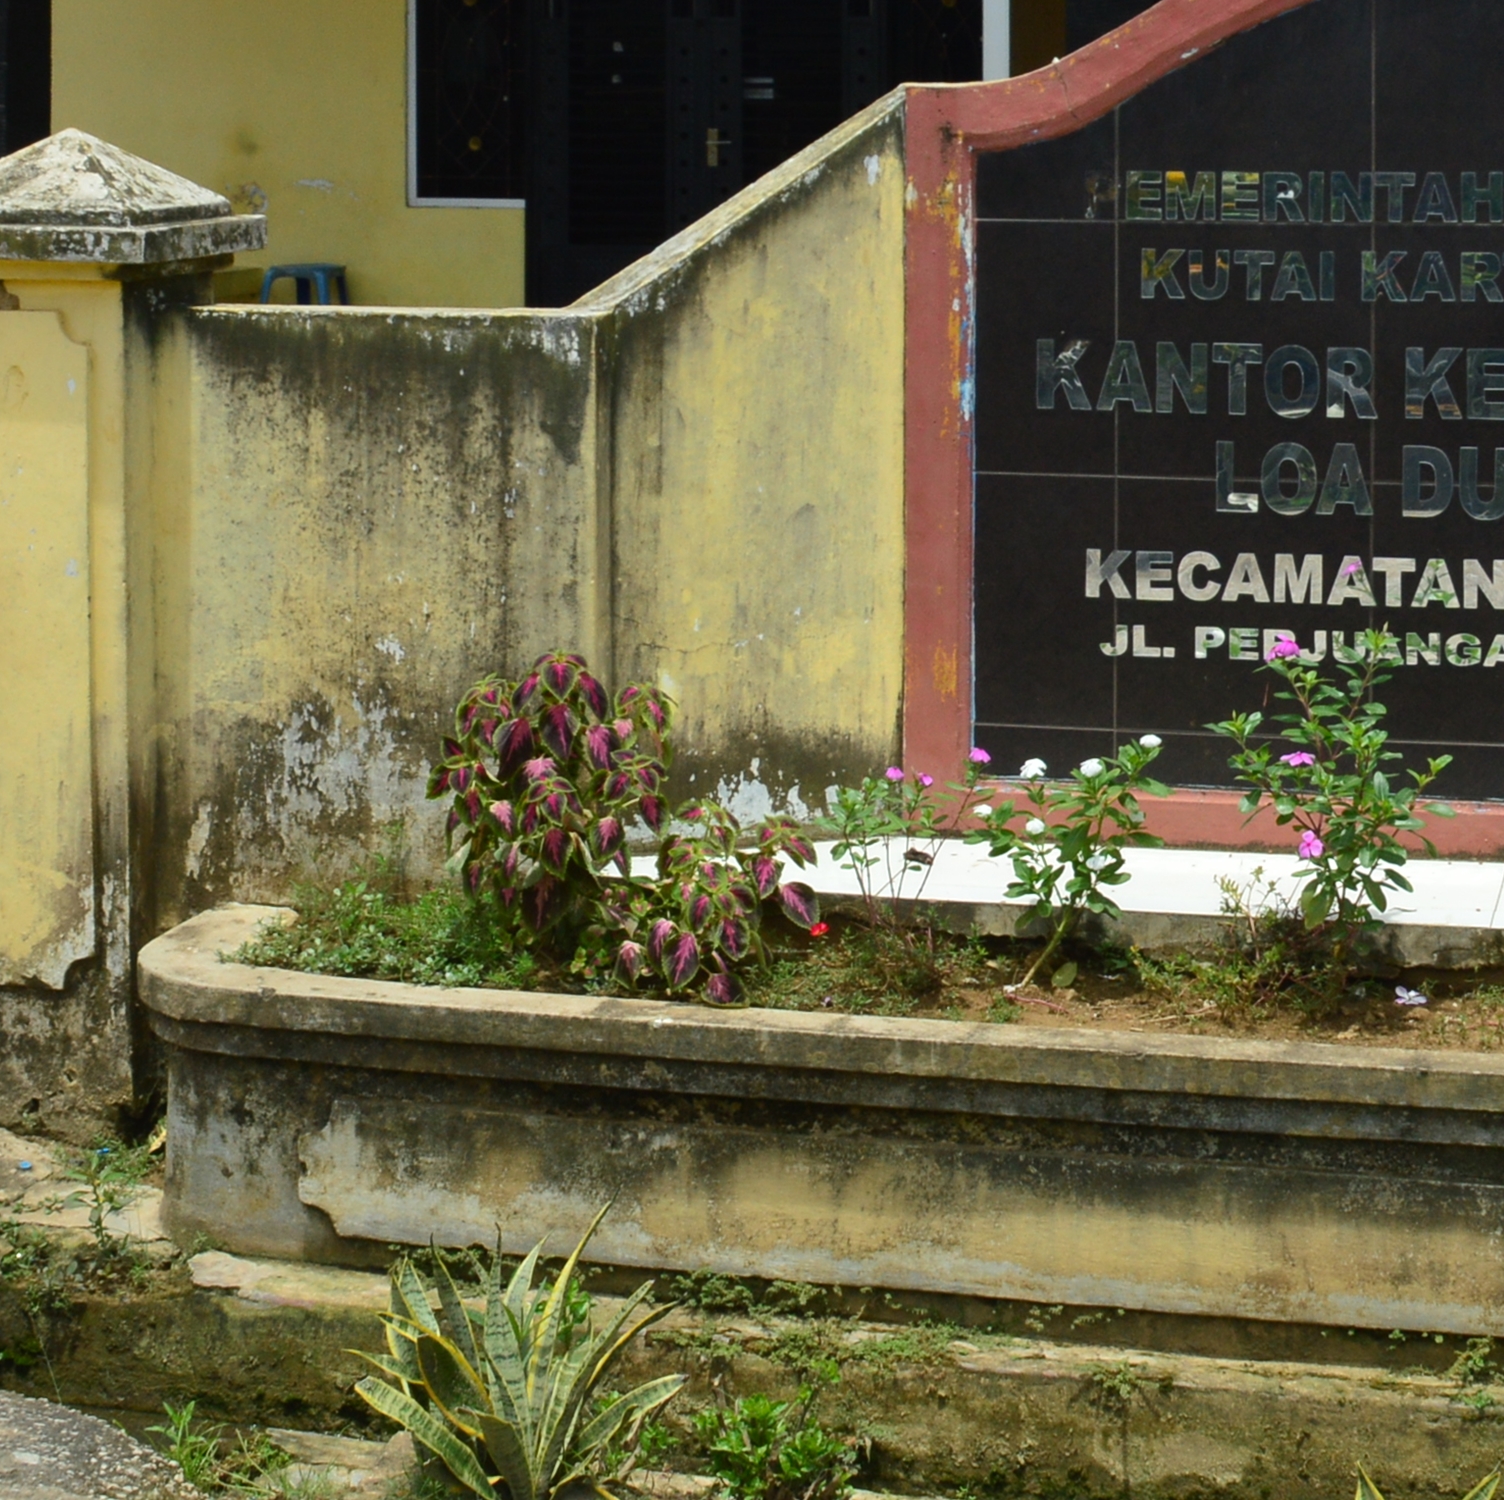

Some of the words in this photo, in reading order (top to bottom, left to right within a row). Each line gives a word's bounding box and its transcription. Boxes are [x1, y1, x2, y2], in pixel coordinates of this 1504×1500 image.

[1140, 247, 1335, 301] KUTAI
[1036, 338, 1378, 419] KANTOR
[1215, 440, 1374, 516] LOA
[1100, 624, 1175, 658] JL.
